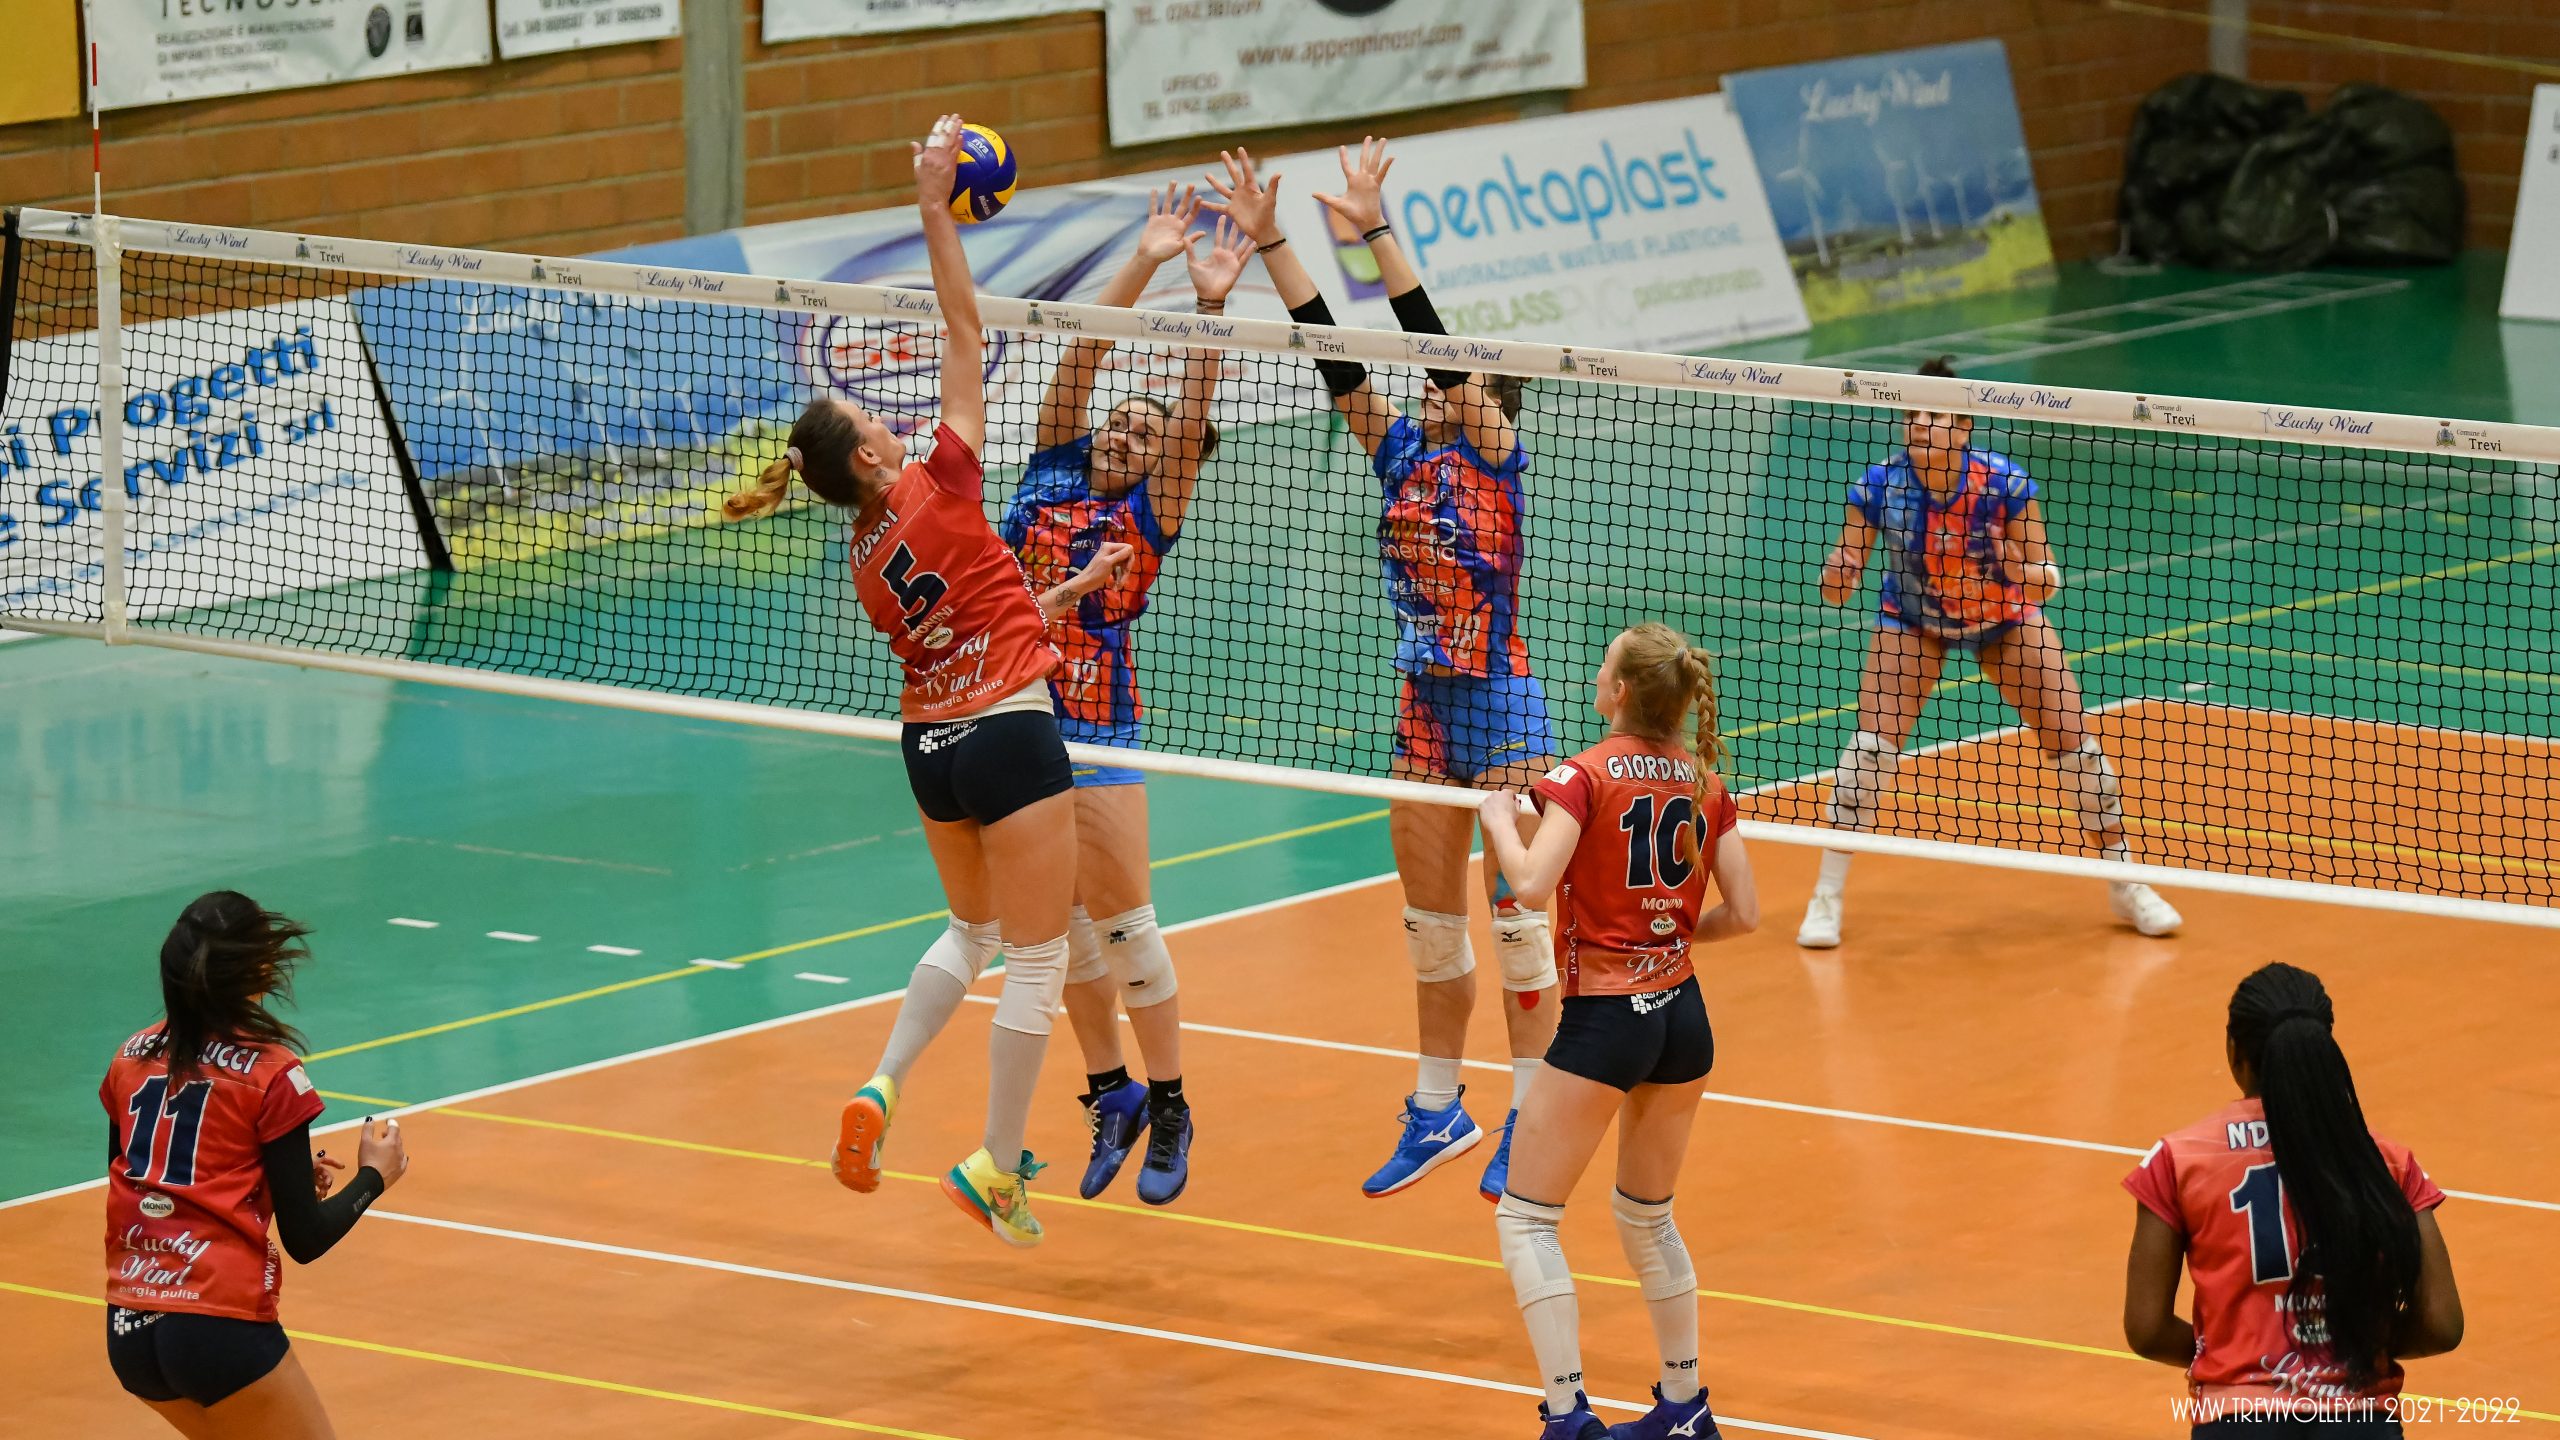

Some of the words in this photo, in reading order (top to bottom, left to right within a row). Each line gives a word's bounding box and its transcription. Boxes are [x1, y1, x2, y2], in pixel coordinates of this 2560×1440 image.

[1402, 128, 1726, 268] pentaplast
[174, 228, 212, 249] Lucky
[214, 230, 249, 249] Wind
[320, 251, 345, 264] Trevi
[406, 250, 444, 270] Lucky
[447, 253, 482, 271] Wind
[556, 272, 583, 286] Trevi
[647, 271, 684, 292] Lucky
[687, 274, 725, 293] Wind
[800, 294, 828, 308] Trevi
[893, 293, 935, 315] Lucky
[1053, 317, 1083, 330] Trevi
[1149, 316, 1192, 337] Lucky
[1195, 319, 1234, 338] Wind
[1316, 340, 1345, 353] Trevi
[1415, 338, 1459, 362] Lucky
[1462, 343, 1503, 362] Wind
[1588, 363, 1618, 377] Trevi
[1690, 362, 1738, 385] Lucky
[1740, 367, 1783, 386] Wind
[50, 326, 319, 457] Pogetti
[1859, 379, 1881, 388] Comune
[1870, 387, 1902, 401] Trevi
[1977, 386, 2026, 410] Lucky
[2029, 390, 2073, 410] Wind
[2152, 403, 2175, 412] Comune
[283, 400, 335, 445] srl
[2164, 412, 2196, 426] Trevi
[2274, 411, 2324, 435] Lucky
[2328, 415, 2375, 436] Wind
[2456, 428, 2479, 437] Comune
[2469, 437, 2502, 452] Trevi
[880, 540, 950, 632] 5
[907, 605, 954, 642] MONINI
[915, 659, 985, 698] Wind
[923, 695, 963, 710] energia
[966, 679, 1004, 702] pulita
[1607, 753, 1697, 783] GIORDAN
[1619, 793, 1708, 890] 10
[123, 1074, 214, 1187] 11
[2226, 1120, 2270, 1150] ND
[142, 1201, 172, 1211] MONINI
[2228, 1160, 2300, 1286] 1
[119, 1223, 212, 1264] Lucky
[120, 1255, 193, 1286] Wind
[160, 1289, 200, 1300] pulita
